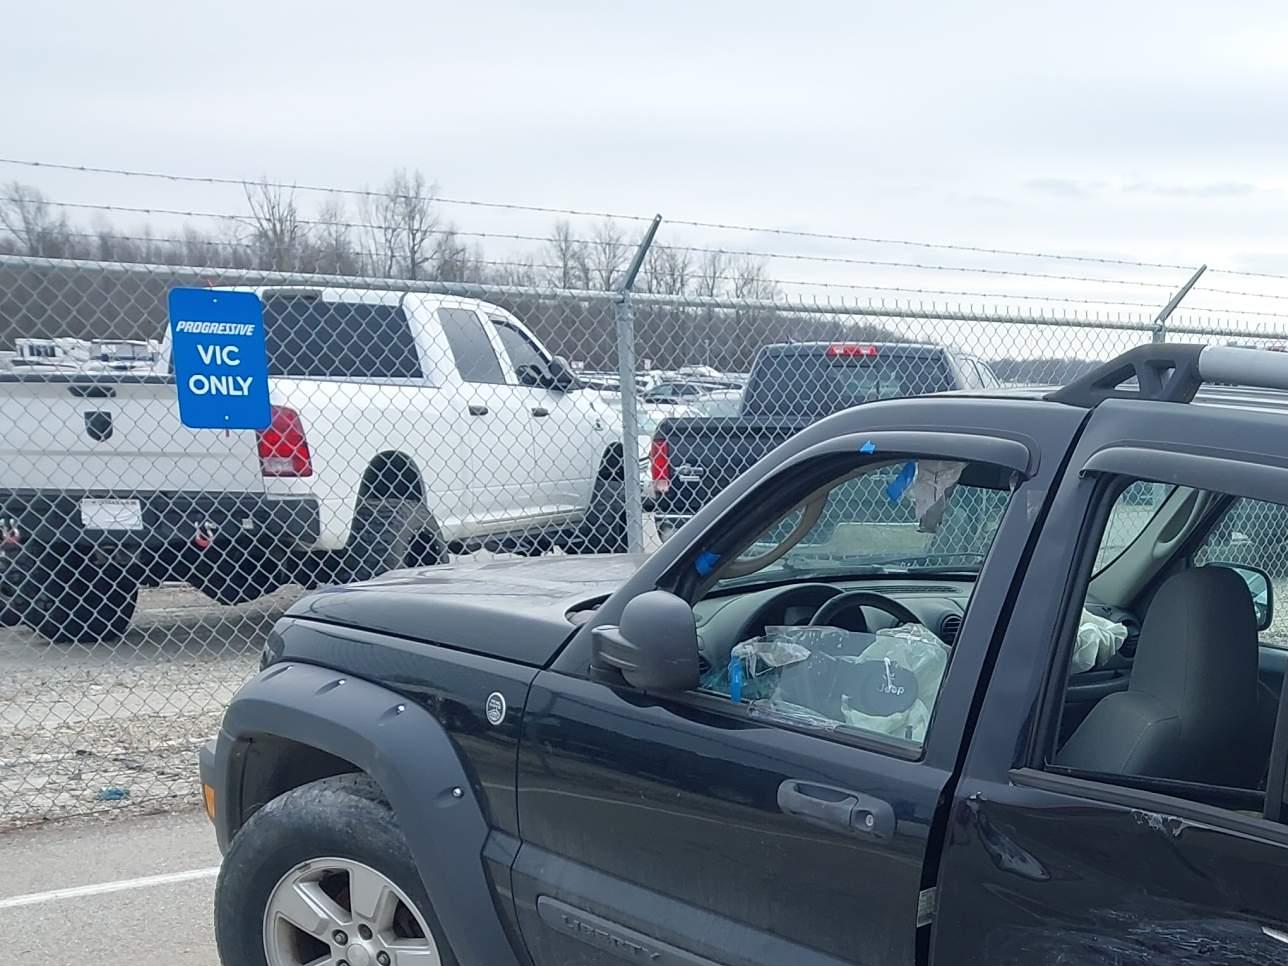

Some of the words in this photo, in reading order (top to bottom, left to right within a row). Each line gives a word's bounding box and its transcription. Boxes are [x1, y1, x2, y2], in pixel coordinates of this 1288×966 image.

[176, 321, 255, 336] PROGRESSIVE
[197, 344, 241, 366] VIC
[188, 374, 253, 396] ONLY
